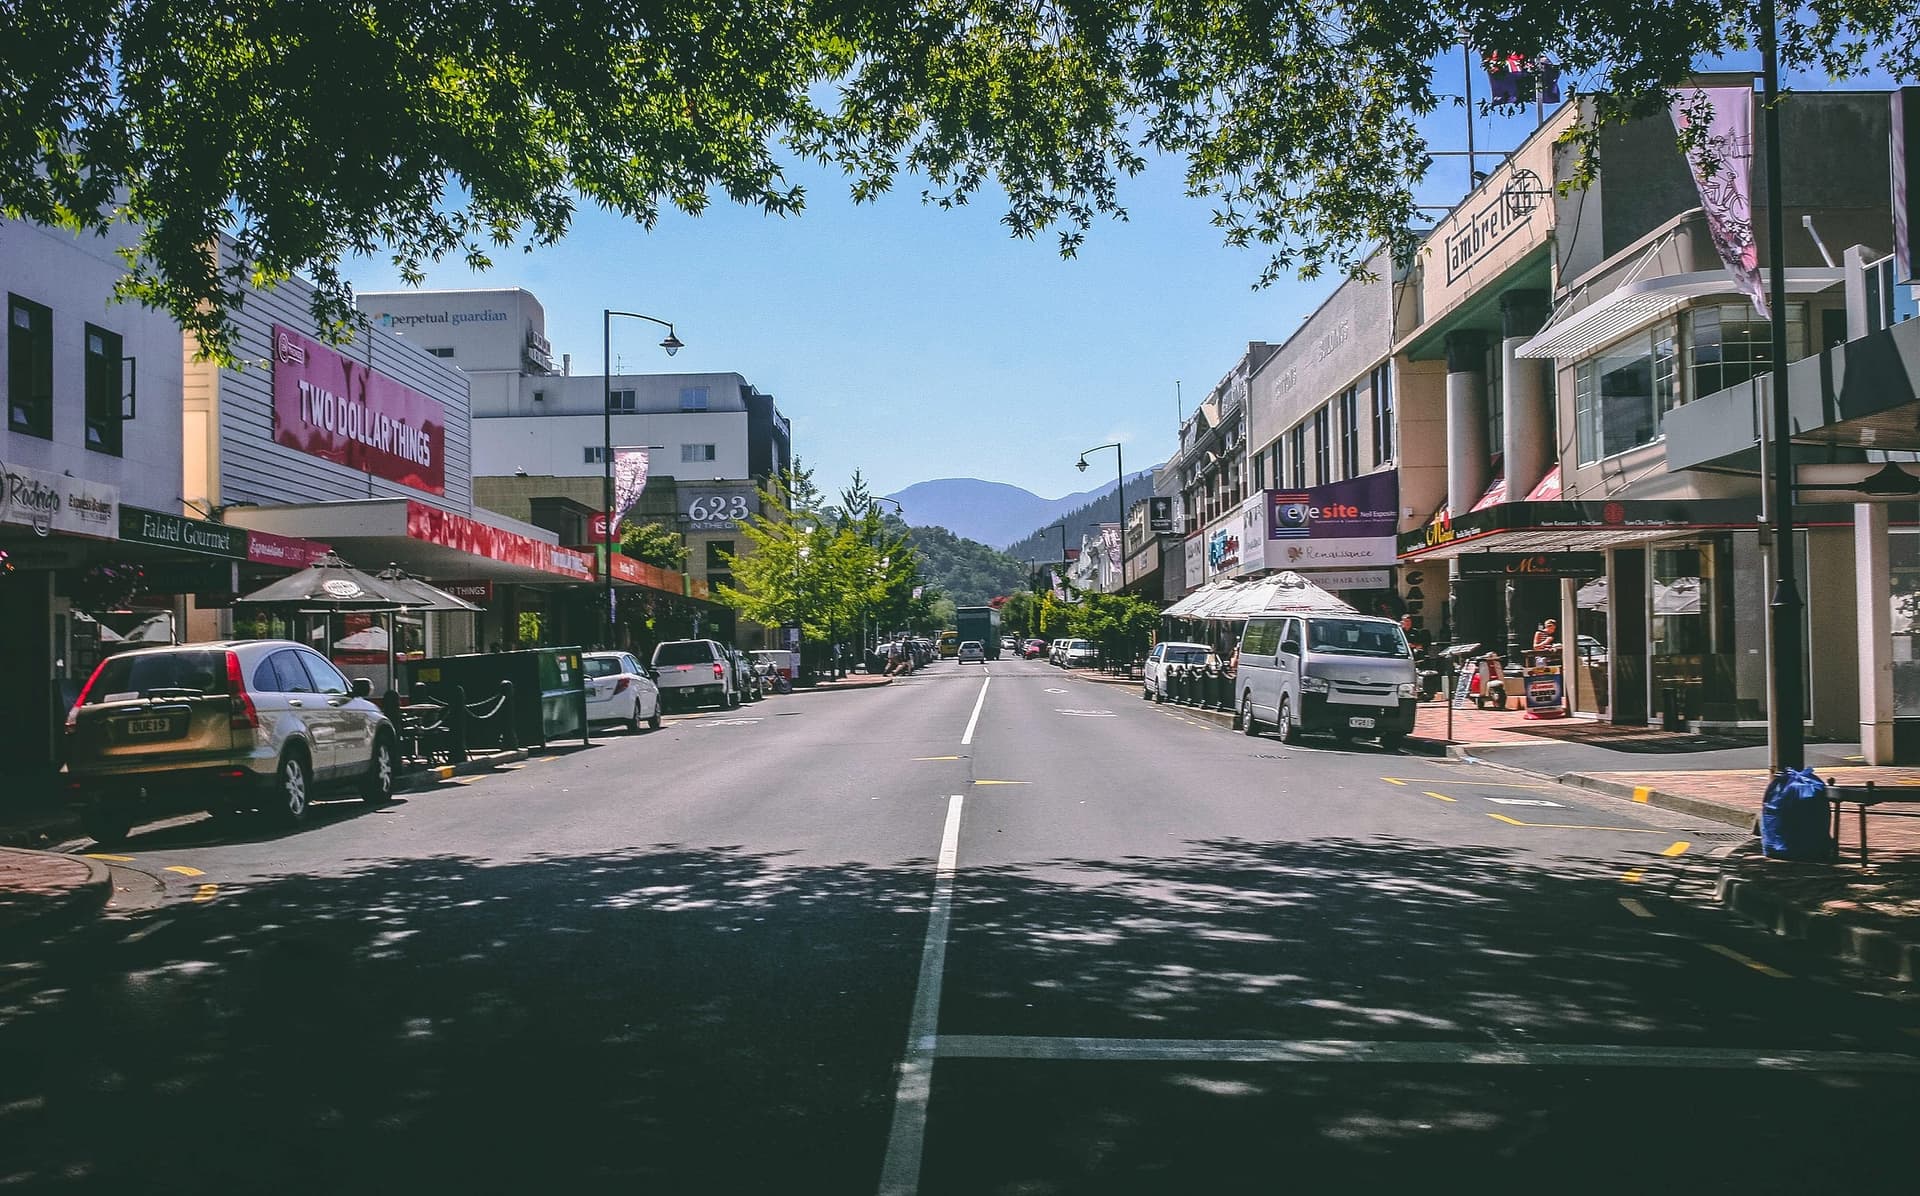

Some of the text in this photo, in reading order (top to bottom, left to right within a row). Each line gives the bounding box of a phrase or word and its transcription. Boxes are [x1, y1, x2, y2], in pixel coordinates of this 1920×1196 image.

[391, 308, 508, 327] perpetual guardian
[297, 379, 431, 467] TWO DOLLAR THINGS
[6, 472, 61, 530] Rodrigo
[688, 495, 749, 521] 623
[1287, 506, 1320, 523] eye
[1322, 503, 1359, 518] site
[142, 514, 230, 551] Falafel Gourmet
[456, 586, 486, 595] THINGS
[132, 719, 166, 733] DUE19
